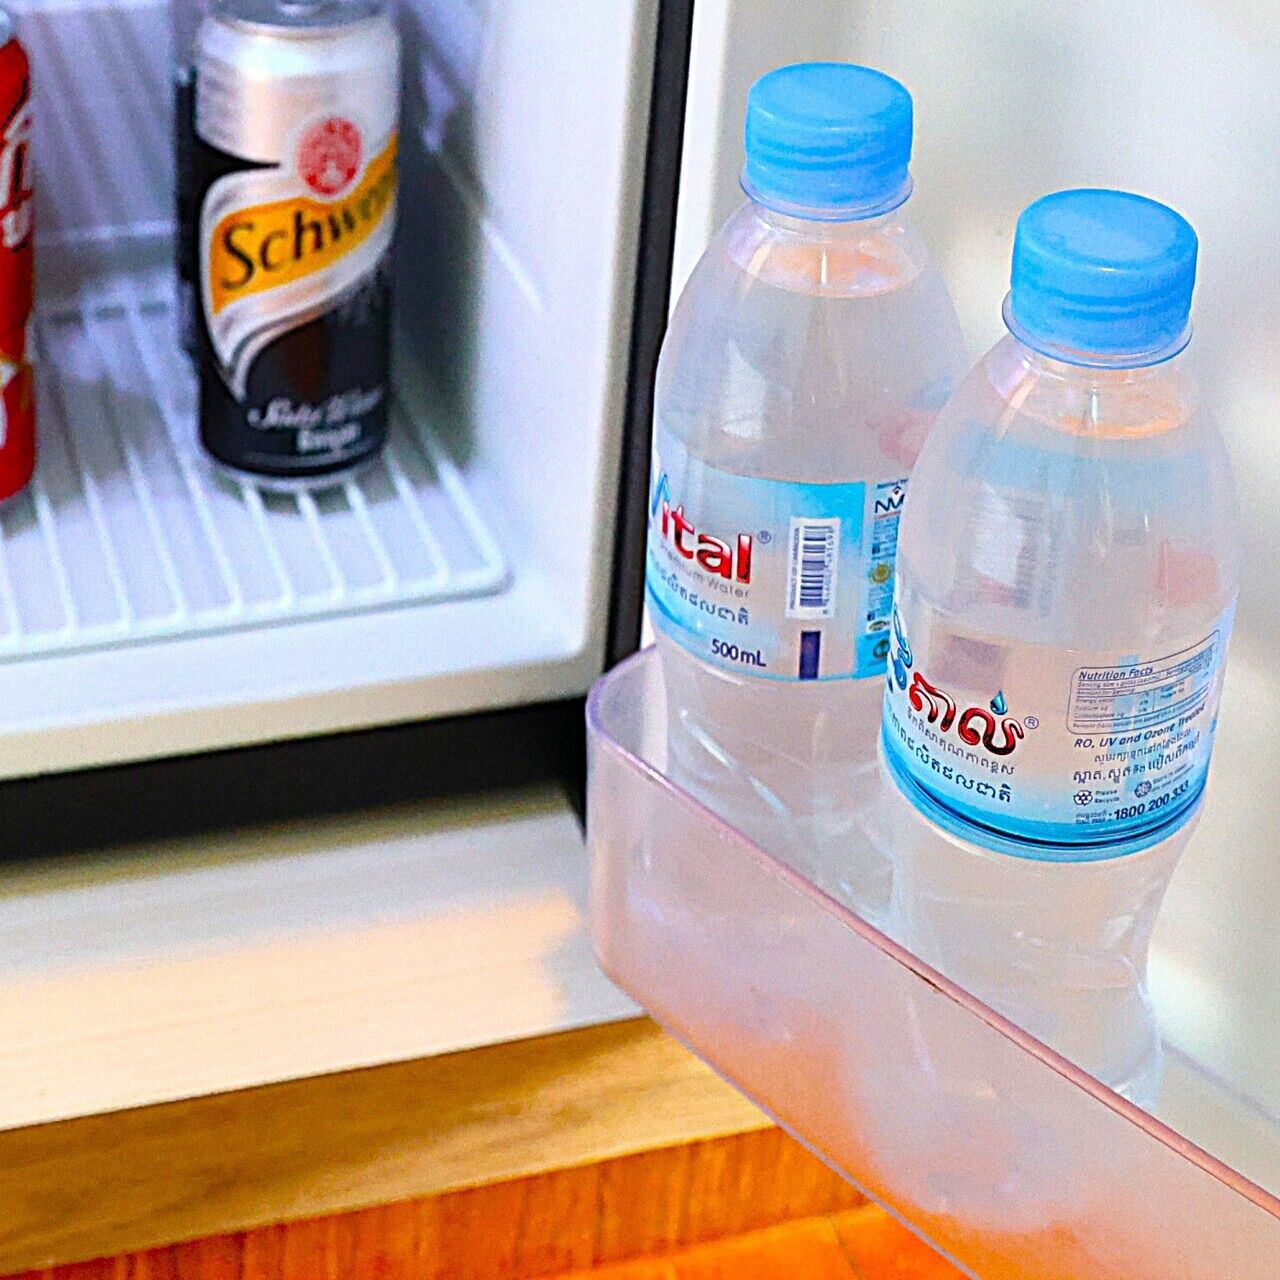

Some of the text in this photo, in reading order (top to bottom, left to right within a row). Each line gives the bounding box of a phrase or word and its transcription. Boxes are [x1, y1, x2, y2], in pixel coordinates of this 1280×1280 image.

[708, 578, 750, 599] Water
[1078, 669, 1126, 681] Nutrition
[1129, 666, 1153, 677] Facts
[1100, 737, 1118, 748] UV
[1119, 733, 1141, 746] and
[1143, 723, 1176, 740] Ozone
[1114, 803, 1146, 821] 1800
[1148, 792, 1171, 811] 200
